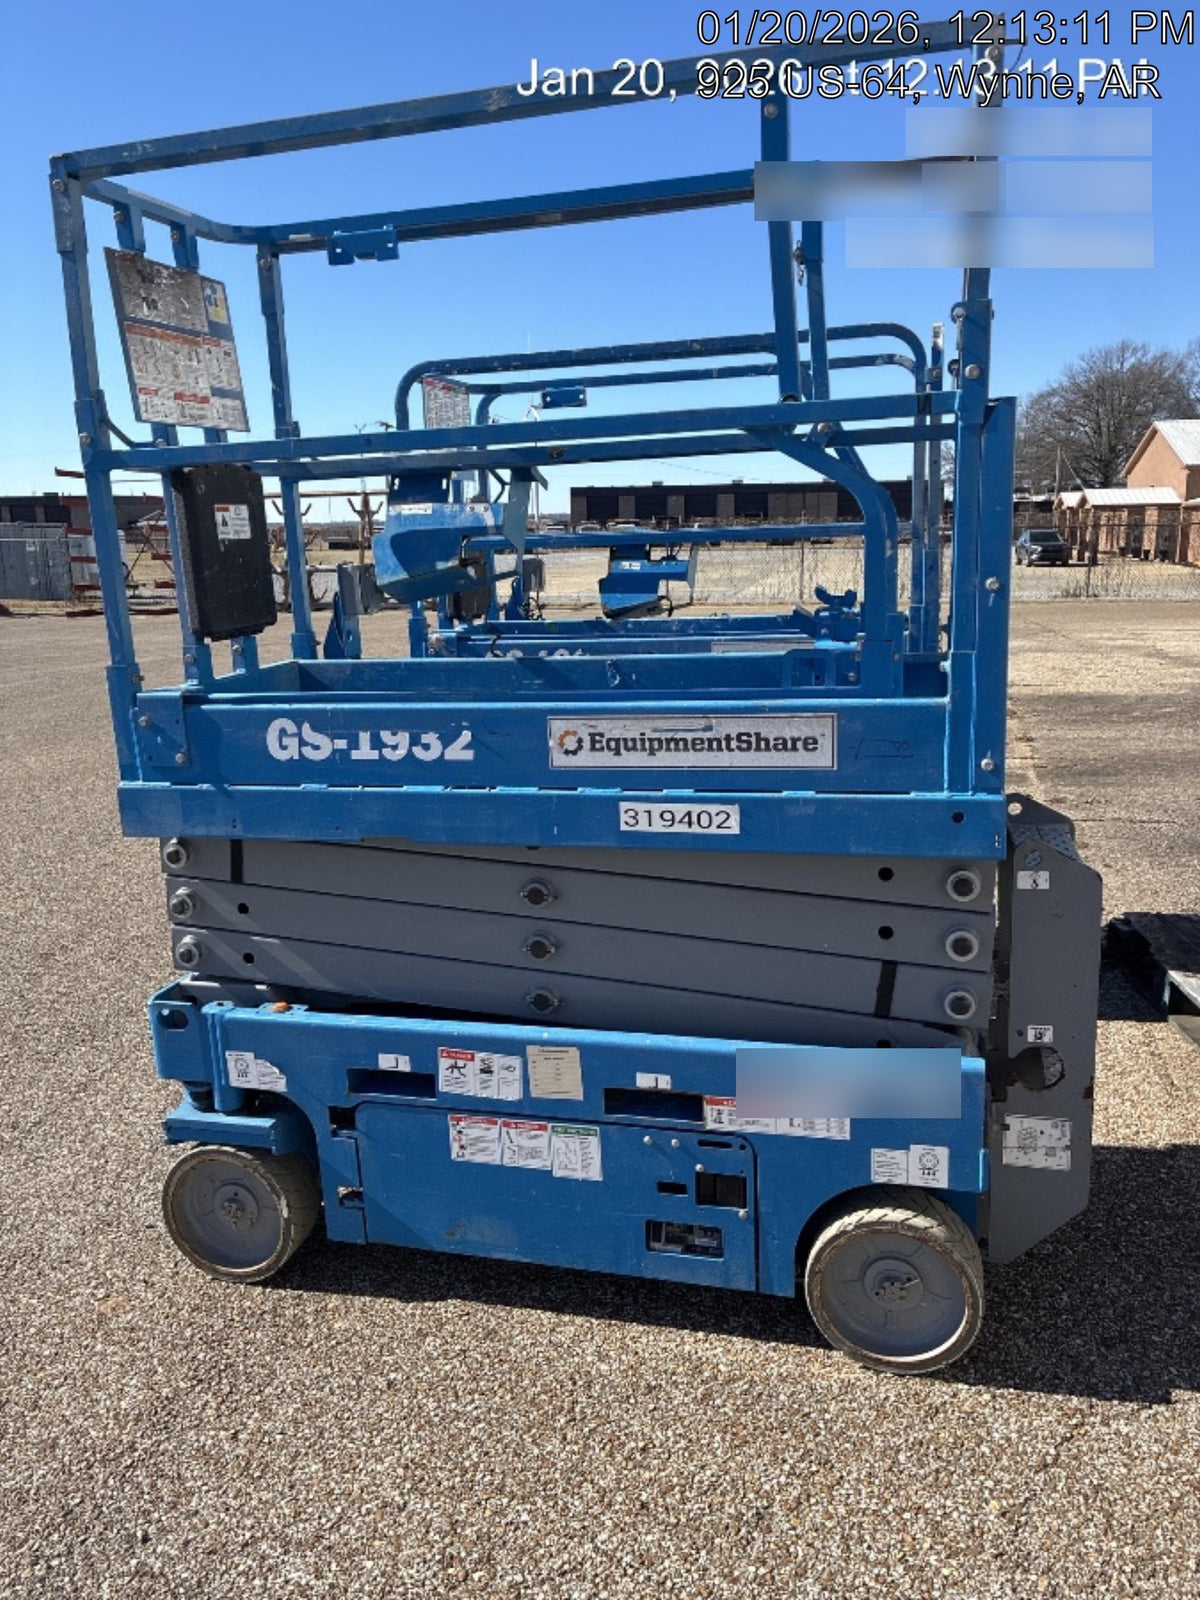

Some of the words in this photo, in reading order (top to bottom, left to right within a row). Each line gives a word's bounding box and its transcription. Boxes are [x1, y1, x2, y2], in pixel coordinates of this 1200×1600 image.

[265, 717, 475, 762] GS-1932
[588, 731, 819, 757] EquipmentShare
[622, 807, 733, 830] 319402
